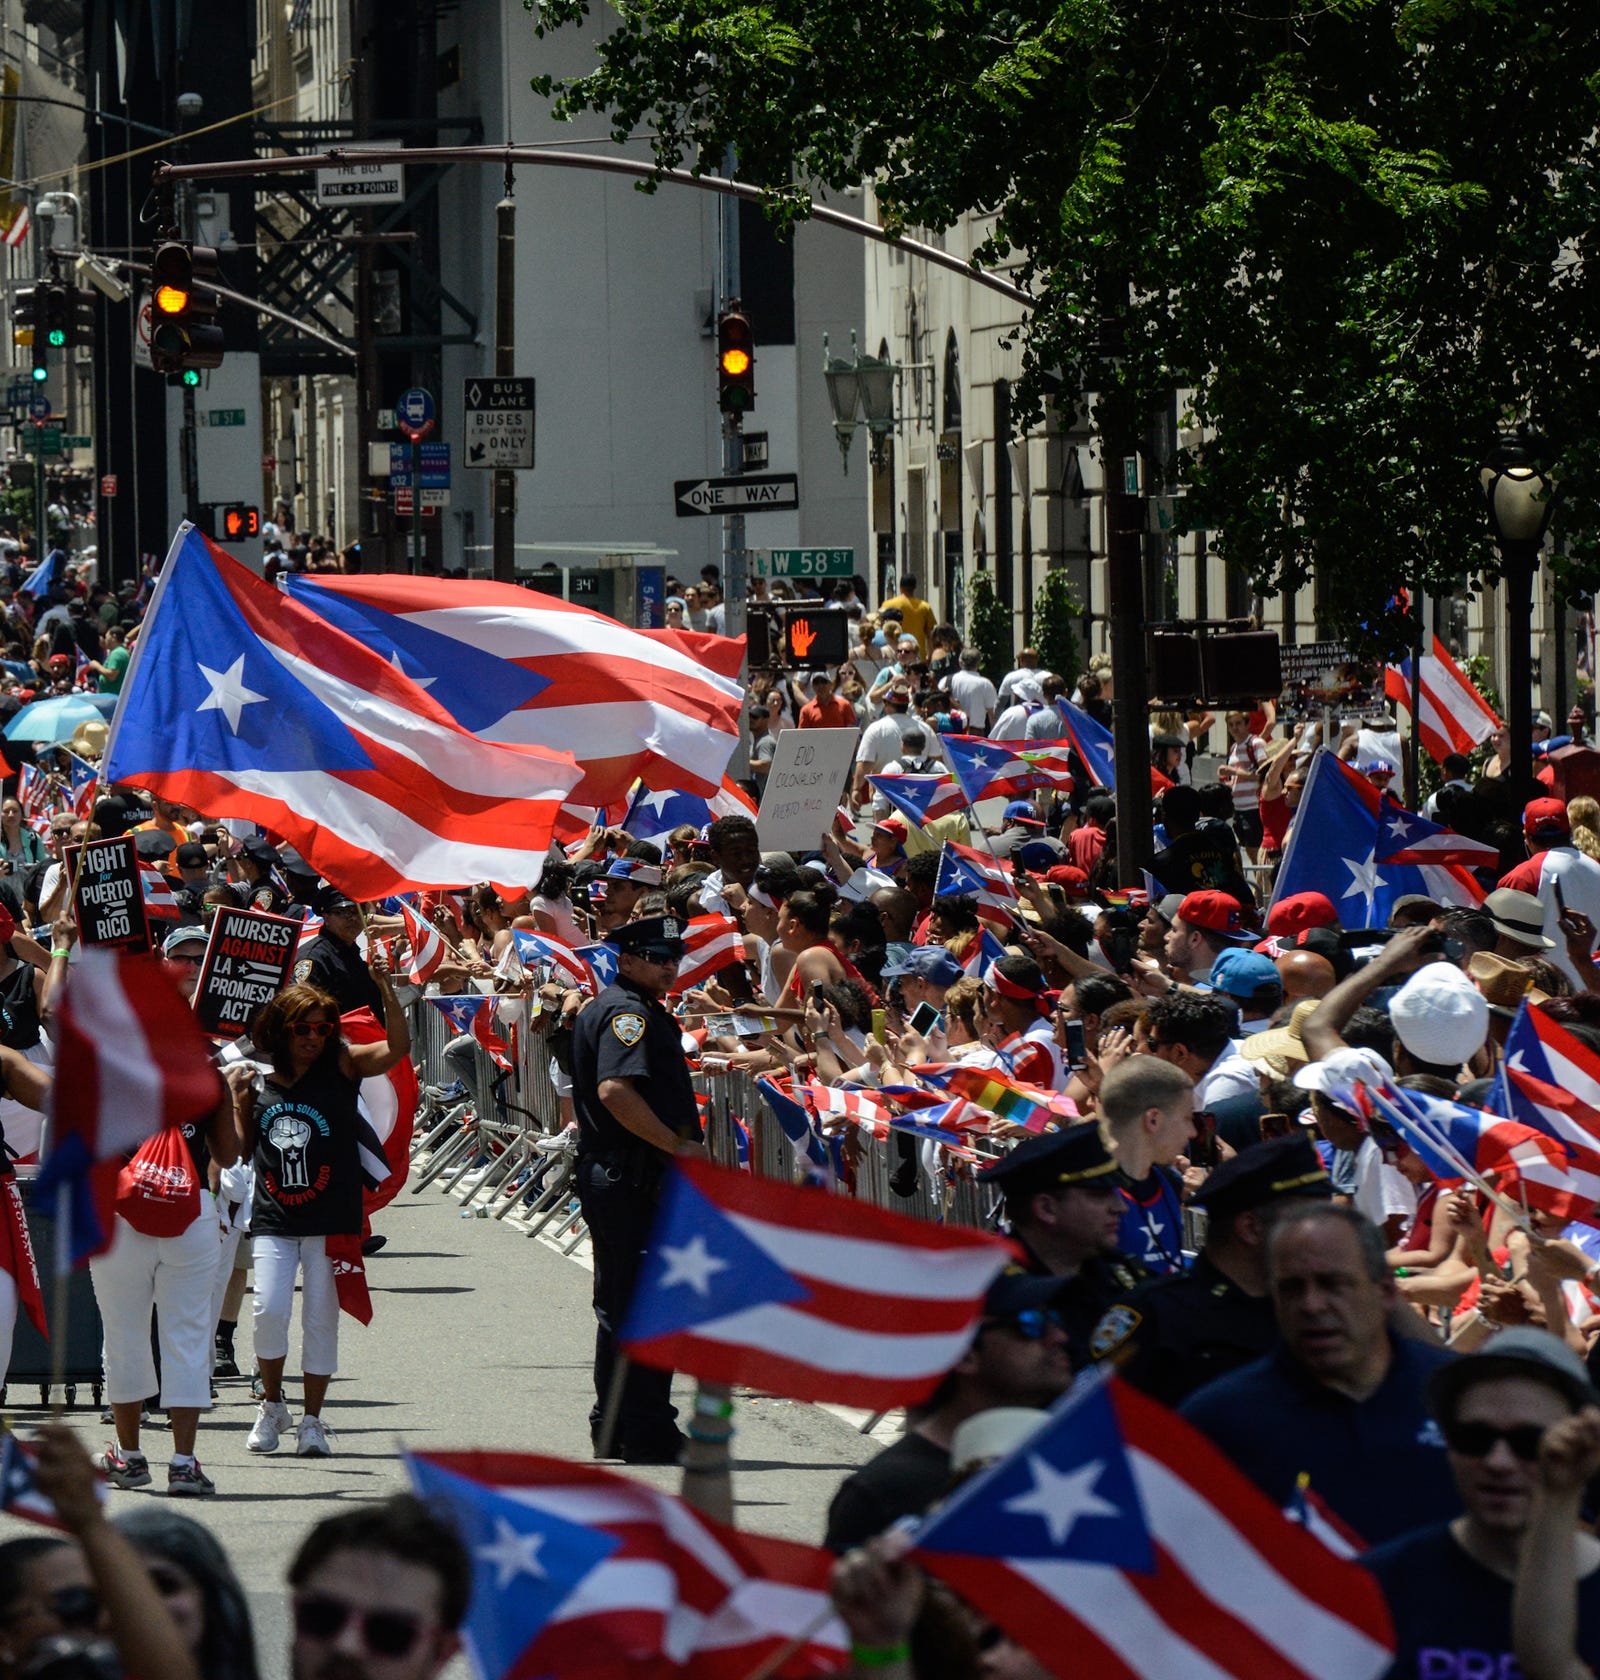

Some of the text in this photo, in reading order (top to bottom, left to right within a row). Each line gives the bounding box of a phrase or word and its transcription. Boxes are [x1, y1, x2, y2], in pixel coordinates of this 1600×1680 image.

[323, 184, 343, 196] FINE
[363, 181, 398, 194] POINTS
[493, 383, 523, 394] BUS
[489, 396, 527, 407] LANE
[211, 412, 221, 425] W
[476, 413, 523, 426] BUSES
[490, 437, 527, 449] ONLY
[690, 485, 781, 505] ONE WAY
[248, 511, 259, 532] 3
[771, 552, 849, 574] W 58 ST
[794, 746, 815, 767] END
[76, 843, 127, 877] FIGHT
[99, 870, 113, 886] for
[81, 878, 134, 907] PUERTO
[95, 914, 131, 941] RICO
[224, 915, 293, 947] NURSES
[219, 936, 288, 965] AGAINST
[212, 954, 232, 976] LA
[208, 975, 276, 1004] PROMESA
[219, 999, 253, 1023] ACT
[260, 1103, 331, 1137] NURSES IN SOLIDARITY
[313, 1164, 331, 1192] RICO
[276, 1188, 317, 1207] PUERTO
